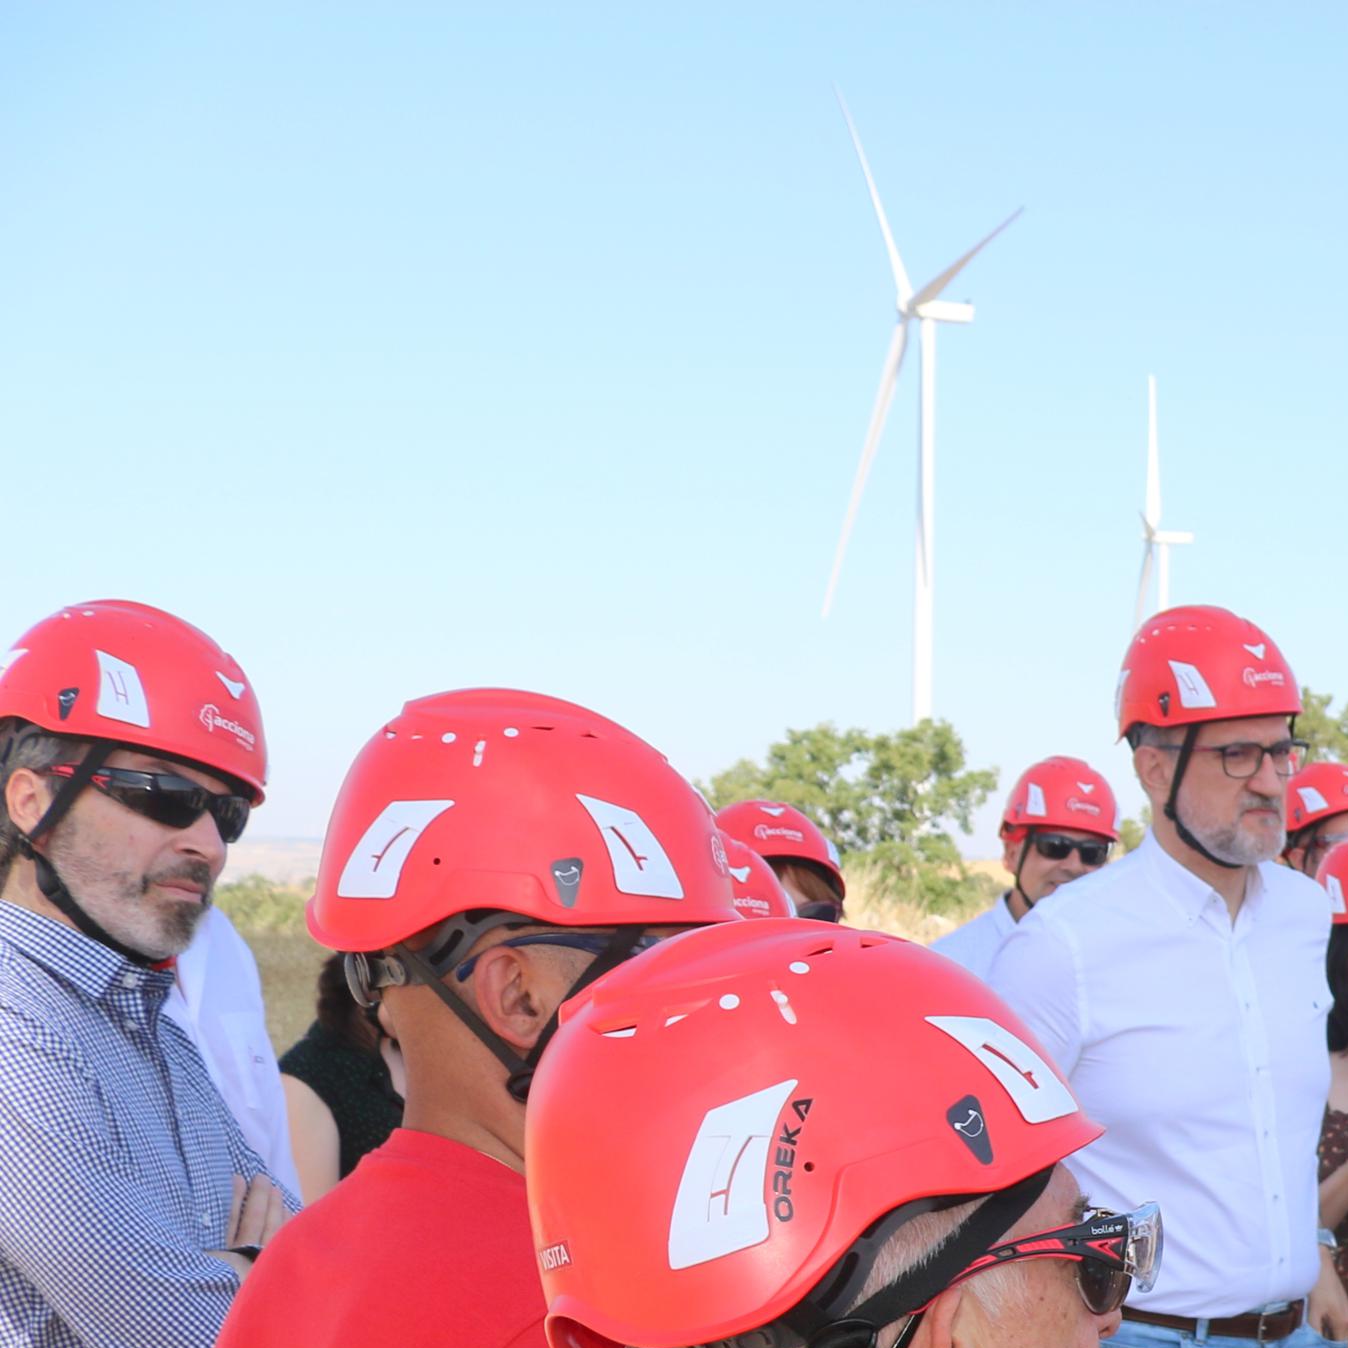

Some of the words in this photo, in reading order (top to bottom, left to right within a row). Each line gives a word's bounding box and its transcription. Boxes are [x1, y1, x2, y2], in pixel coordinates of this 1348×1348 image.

[214, 715, 255, 745] acciona
[773, 1098, 813, 1222] OREKA
[1091, 1224, 1115, 1235] bollé
[540, 1244, 570, 1271] VISITA
